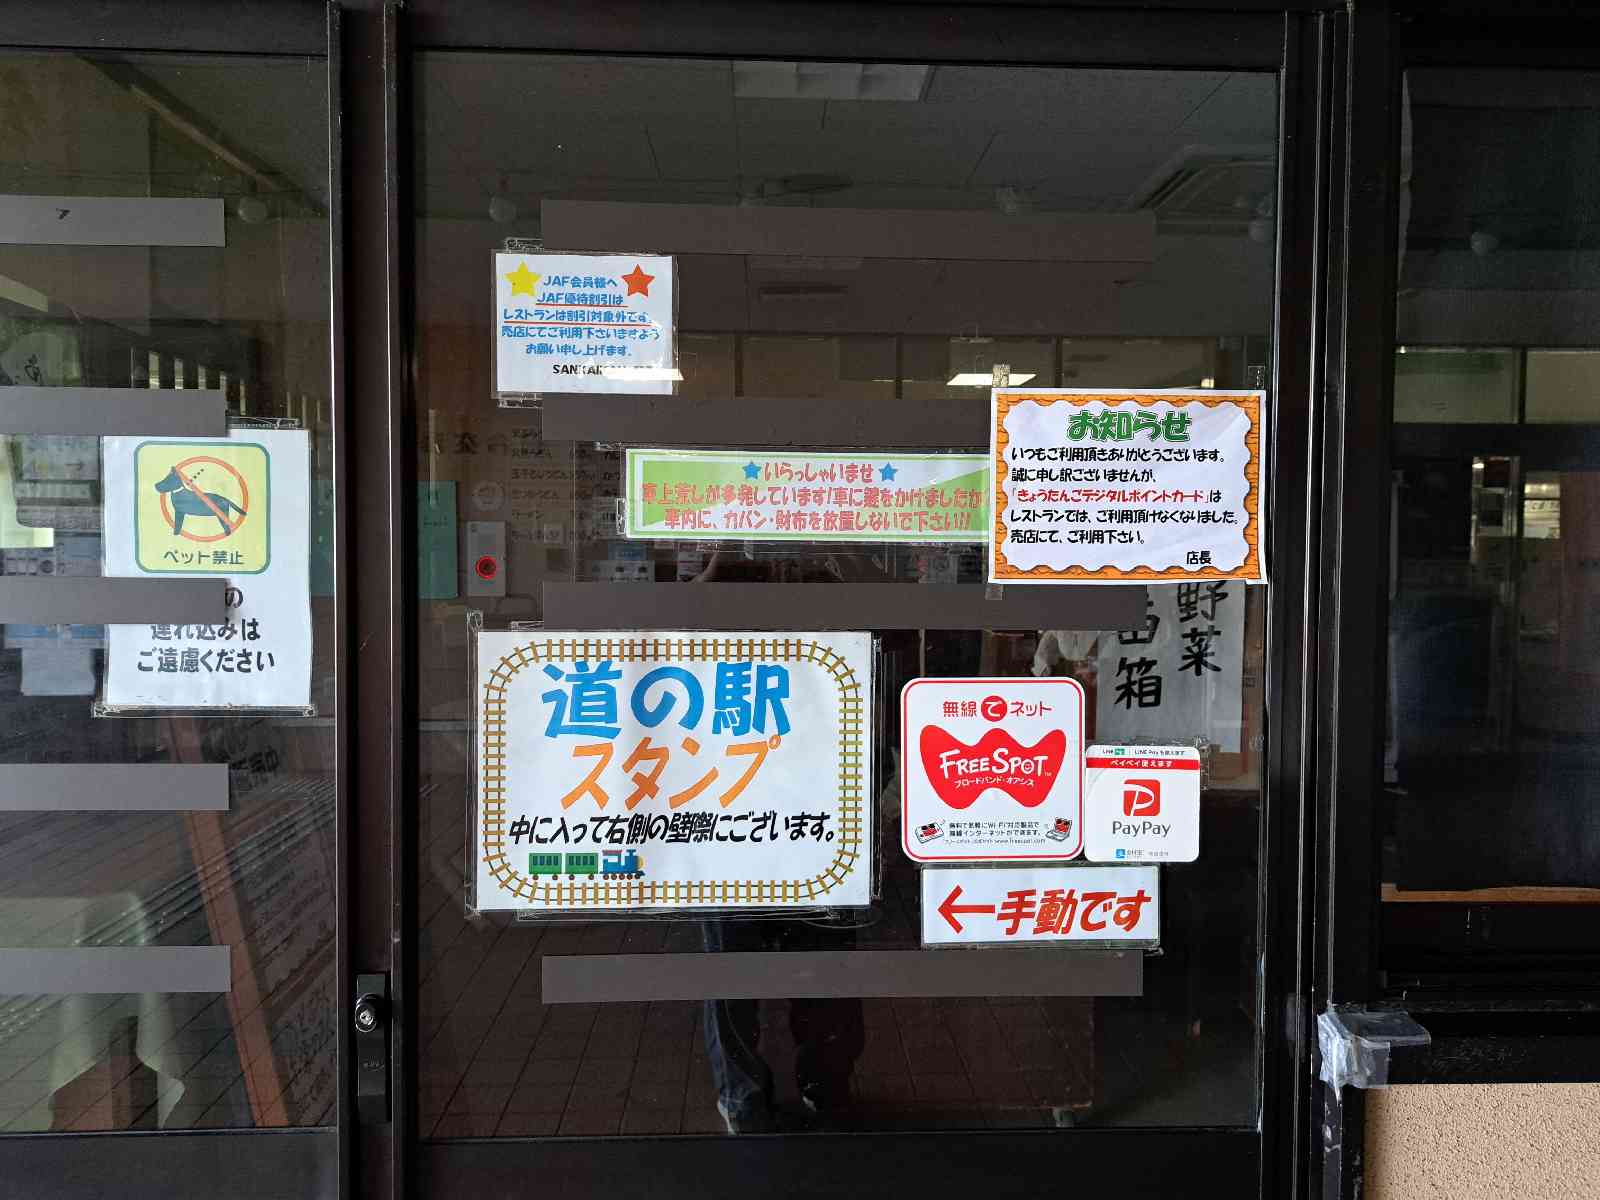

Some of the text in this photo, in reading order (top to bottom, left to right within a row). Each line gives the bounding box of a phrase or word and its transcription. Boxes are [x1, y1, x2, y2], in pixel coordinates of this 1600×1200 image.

[543, 275, 618, 289] JAF会員様へ
[537, 292, 624, 305] JAF優待割引は
[1066, 408, 1193, 443] お知らせ
[1011, 447, 1225, 463] いつもご利用頂きありがとうございます。
[763, 461, 874, 483] いらっしゃいませ
[1011, 467, 1157, 483] 誠に申し訳ございませんが、
[1011, 488, 1222, 504] 「きょうたんごデジタルポイントカード」は
[1010, 509, 1239, 525] レストランでは、ご利用頂けなくなりました。
[1010, 529, 1145, 545] 売店にて、ご利用下さい。
[163, 549, 245, 565] ペット禁止
[1186, 550, 1213, 566] 店長
[137, 647, 275, 674] ご遠慮ください
[541, 660, 792, 740] 道の駅
[942, 695, 1054, 722] 無線でネット
[560, 734, 782, 811] スタンプ
[508, 809, 835, 845] 中に入って右側の壁際にございます。
[1112, 820, 1171, 838] PayPay
[996, 888, 1153, 936] 手動です
